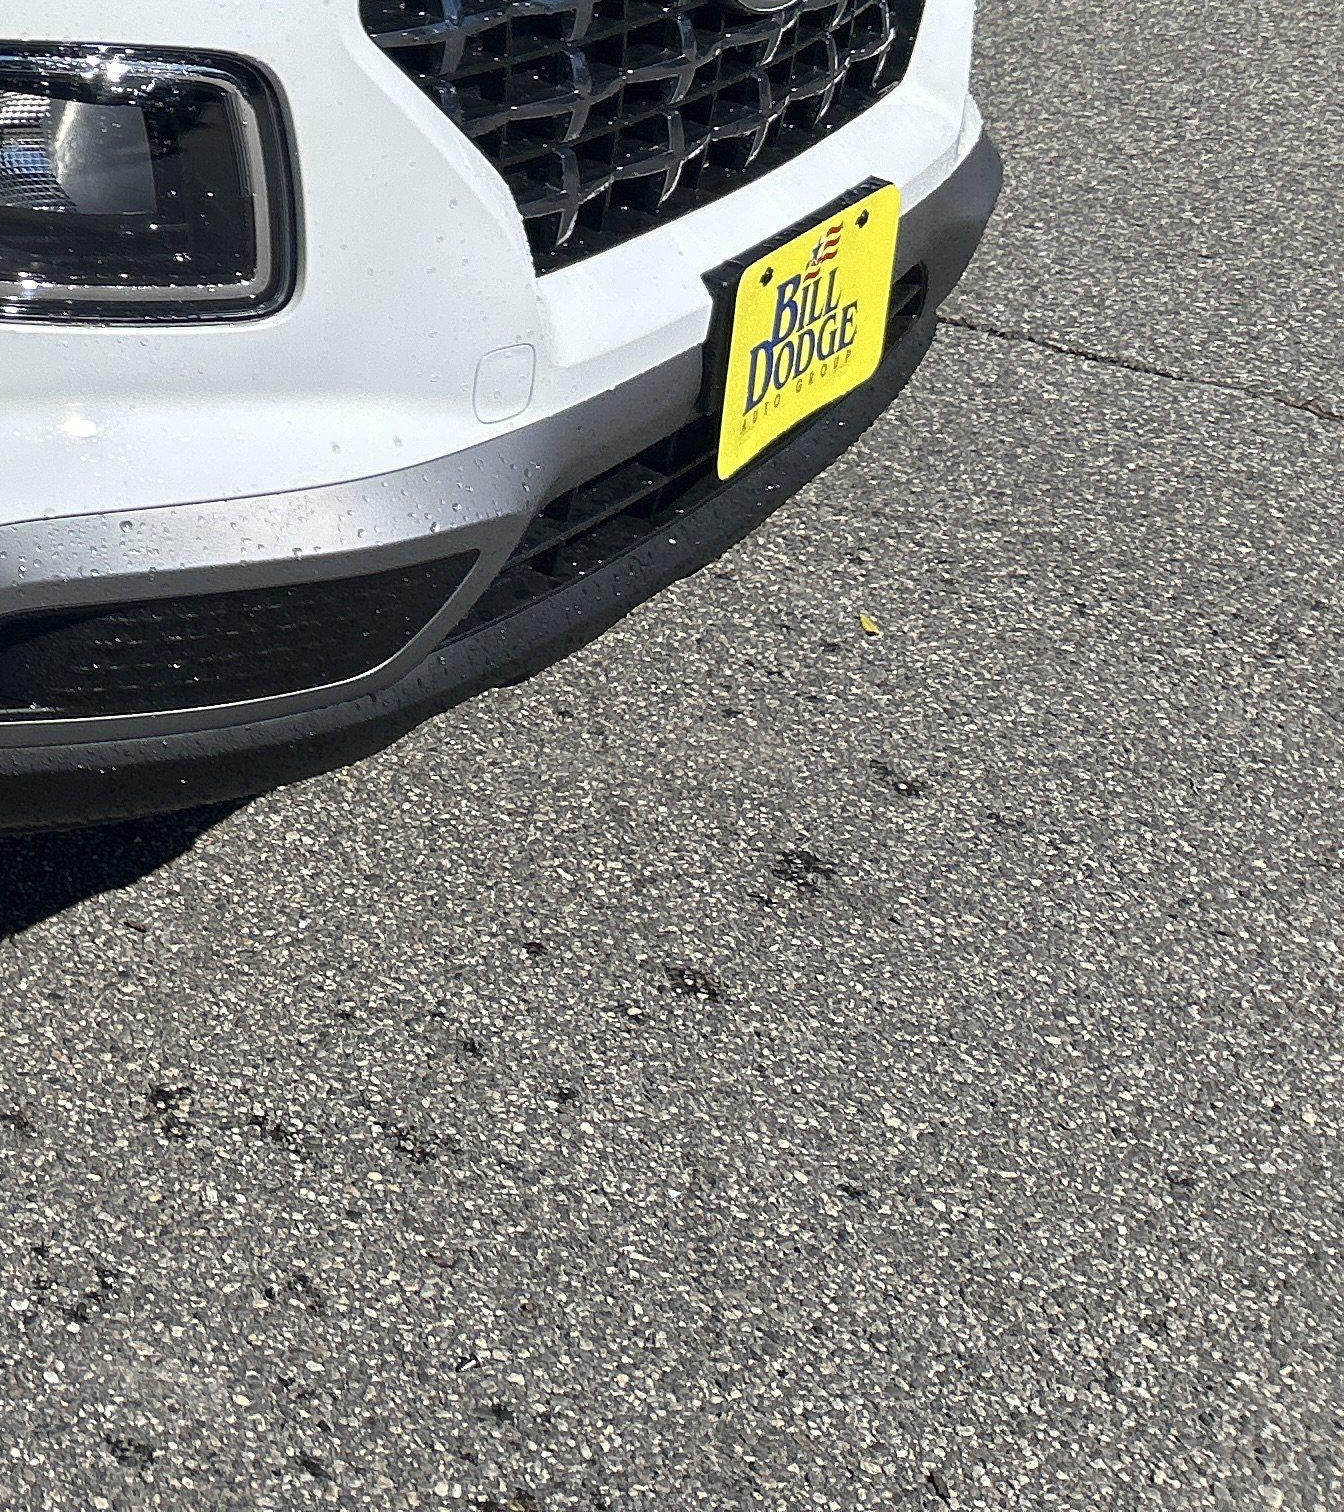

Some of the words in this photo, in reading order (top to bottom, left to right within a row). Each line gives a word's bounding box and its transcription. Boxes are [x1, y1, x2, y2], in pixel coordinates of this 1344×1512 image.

[771, 266, 842, 347] BILL
[741, 394, 781, 431] AUTO
[795, 349, 852, 393] GROUP
[743, 301, 859, 416] DODGE
